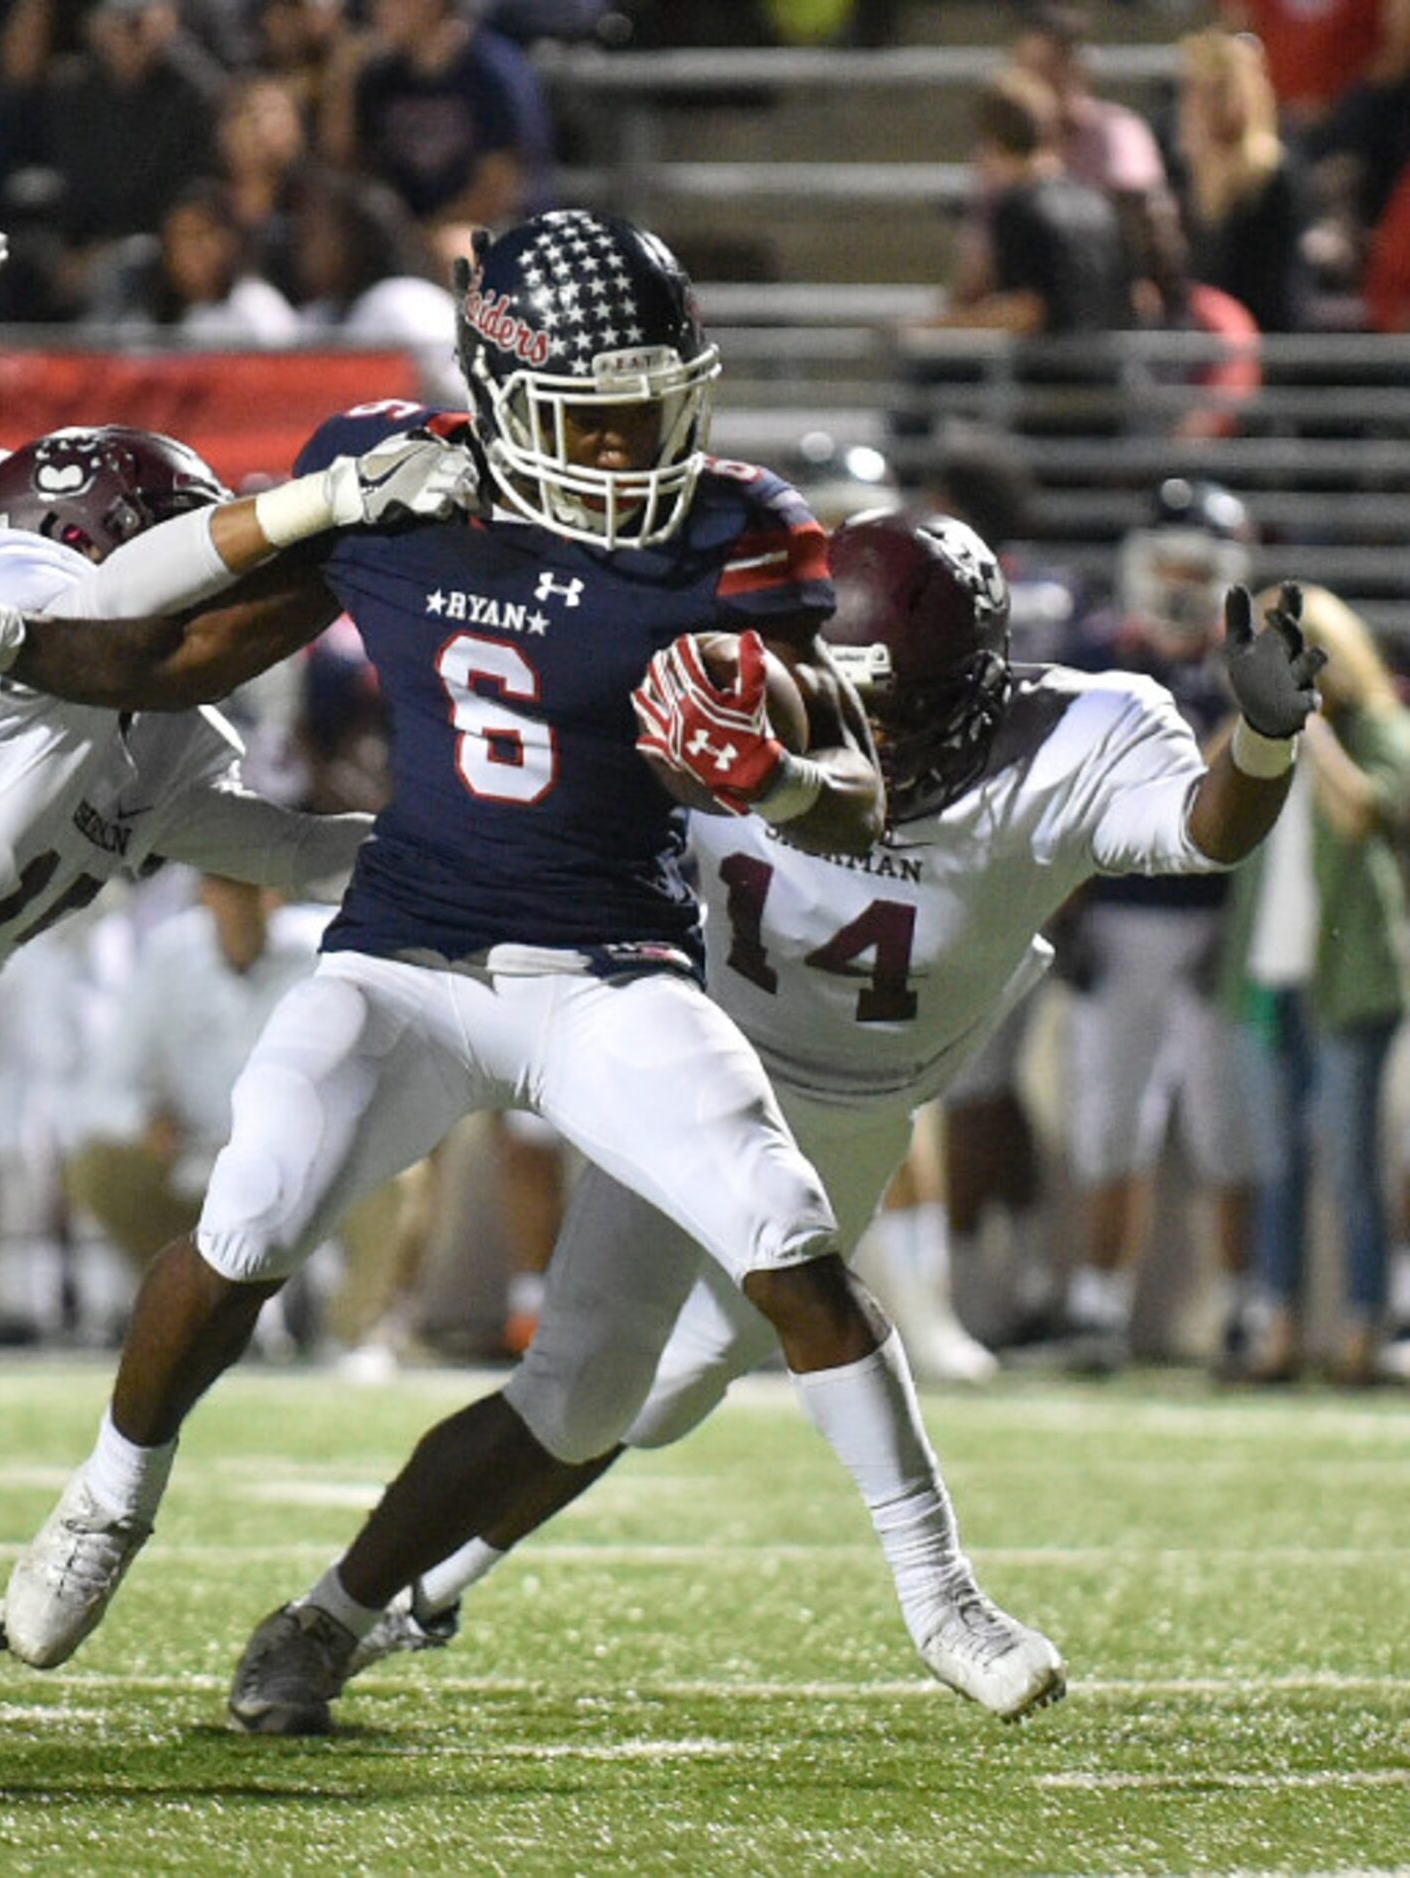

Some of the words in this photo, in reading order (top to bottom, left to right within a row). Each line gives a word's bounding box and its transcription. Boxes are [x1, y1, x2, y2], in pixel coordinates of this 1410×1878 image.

[446, 591, 527, 631] RYAN
[434, 629, 559, 806] 6
[719, 852, 918, 1022] 14
